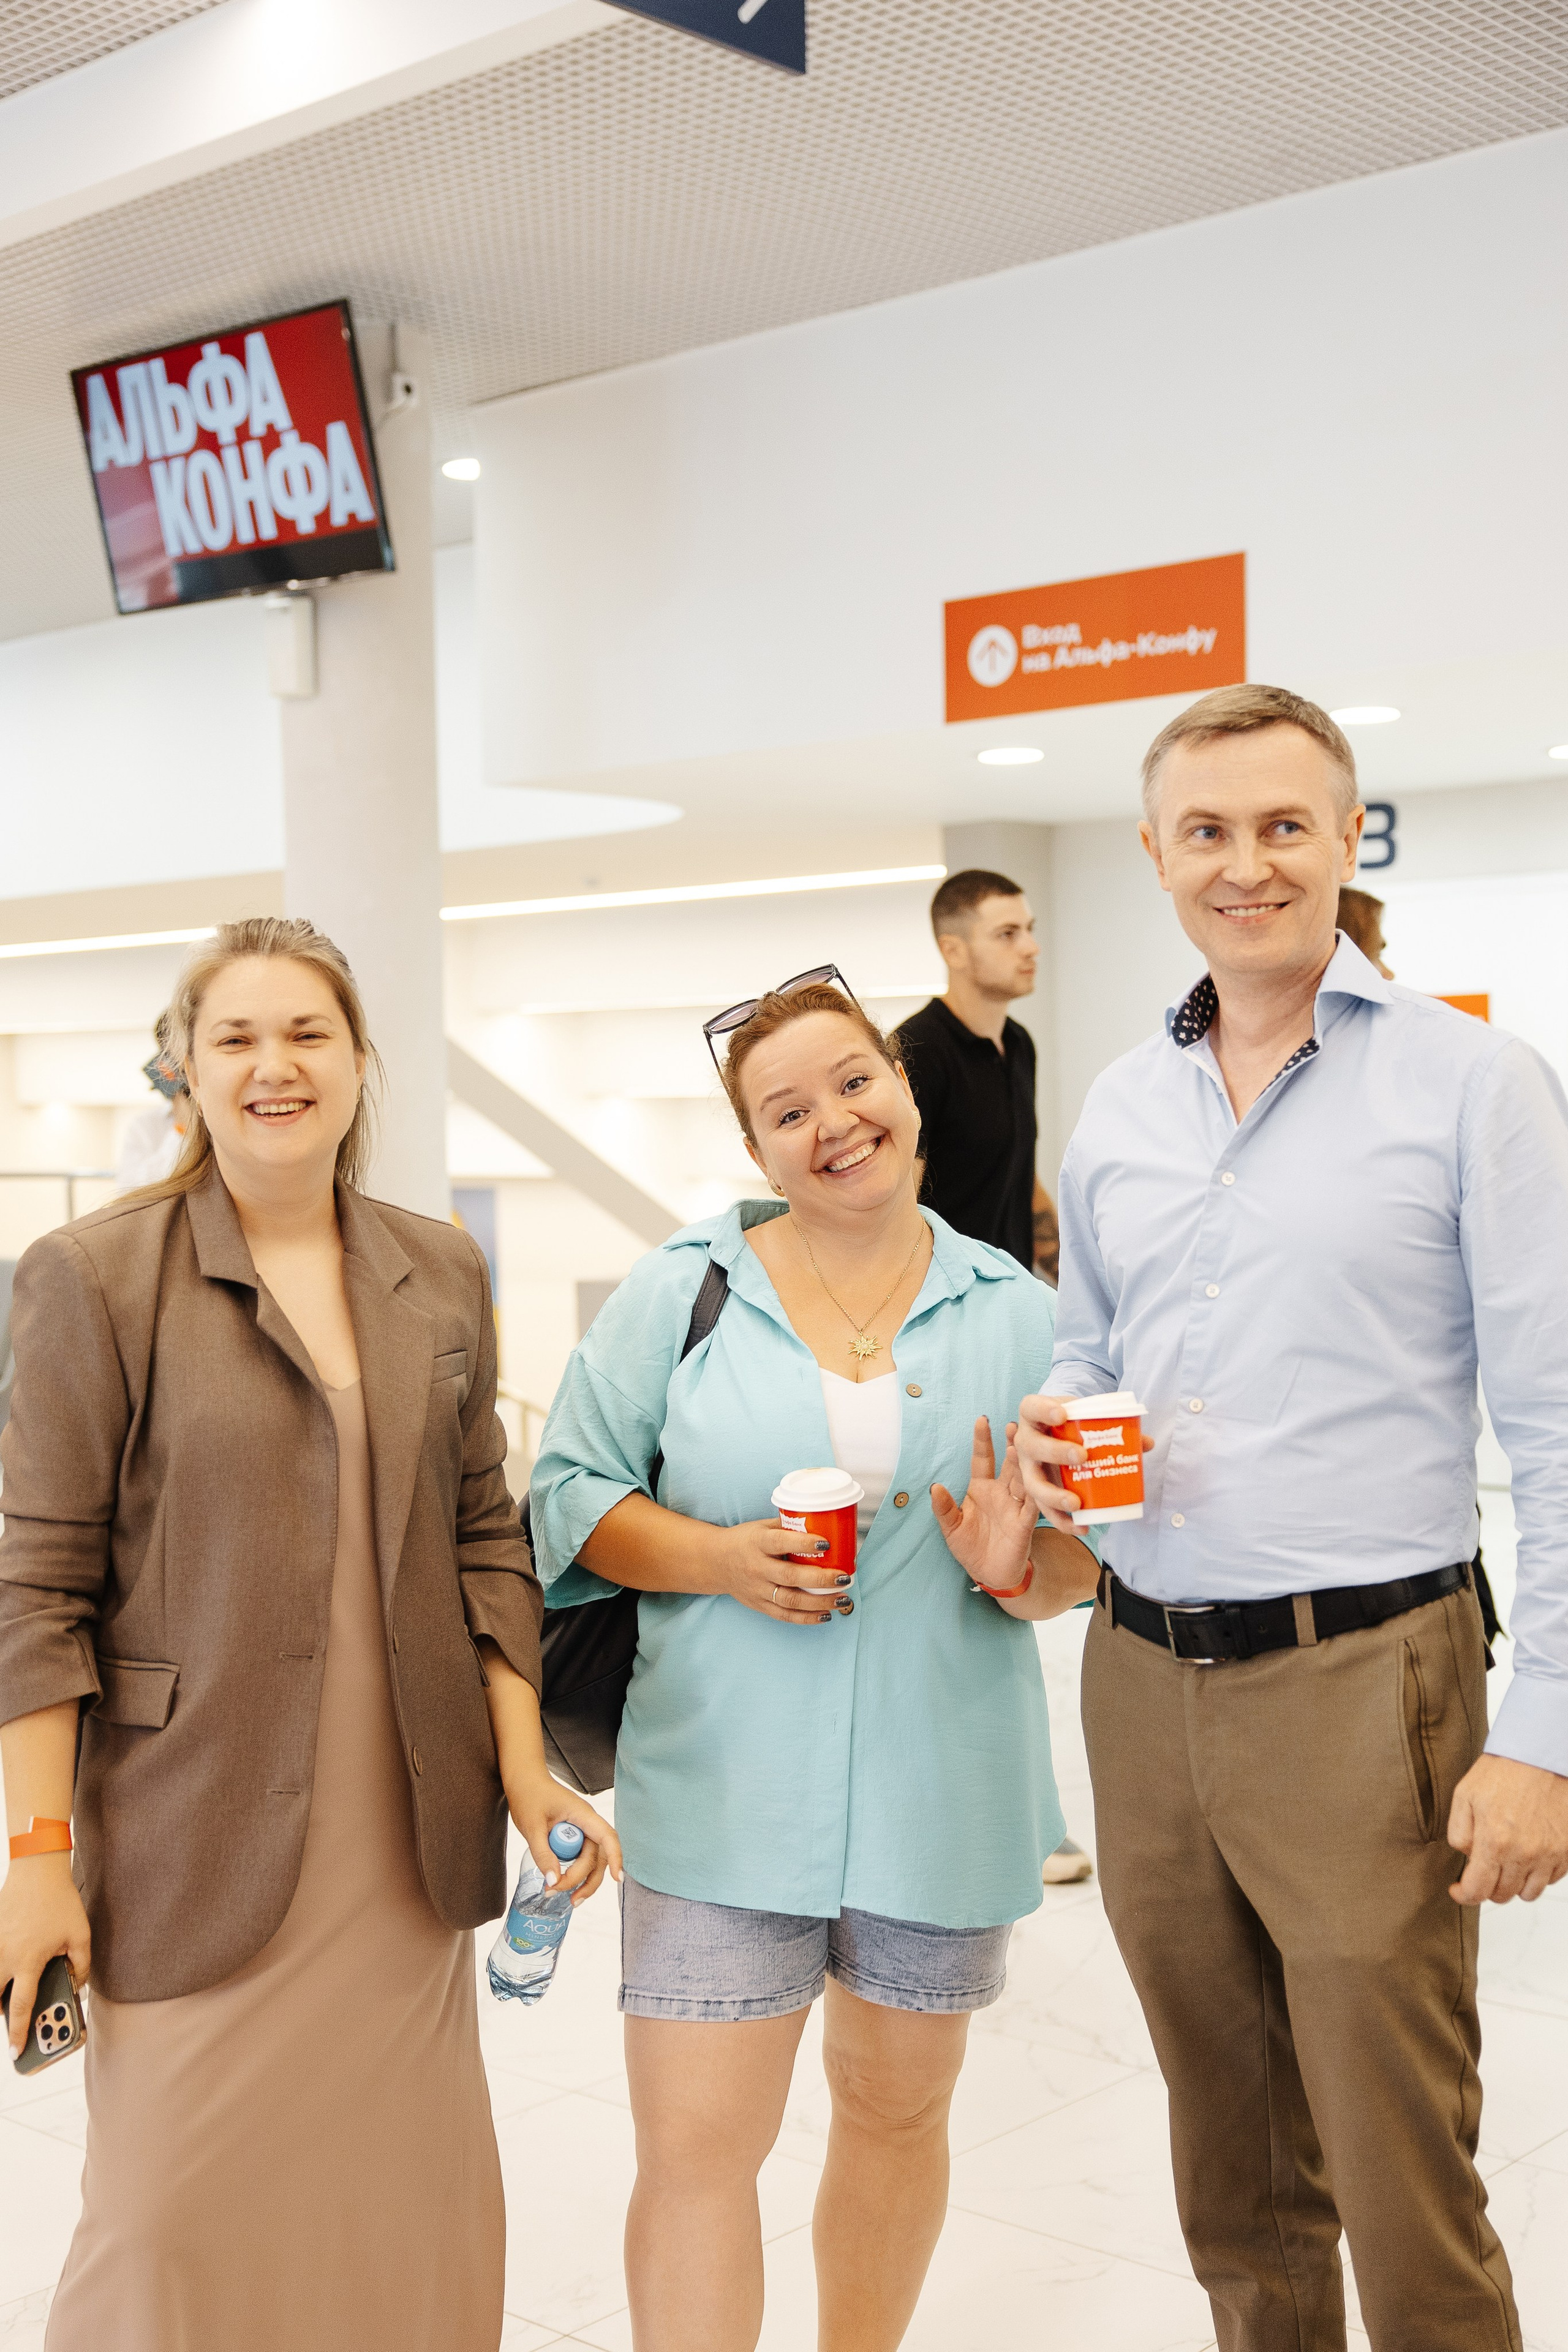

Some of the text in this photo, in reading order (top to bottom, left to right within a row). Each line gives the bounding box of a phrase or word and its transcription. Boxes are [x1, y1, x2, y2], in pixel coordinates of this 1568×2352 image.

[86, 330, 294, 473] АЛЬФА
[148, 420, 377, 557] КОНФА
[1022, 624, 1218, 674] на Альфа-Конфу
[1072, 1464, 1138, 1482] для бизнеса
[1116, 1453, 1139, 1464] банк
[523, 1919, 565, 1936] AQUA
